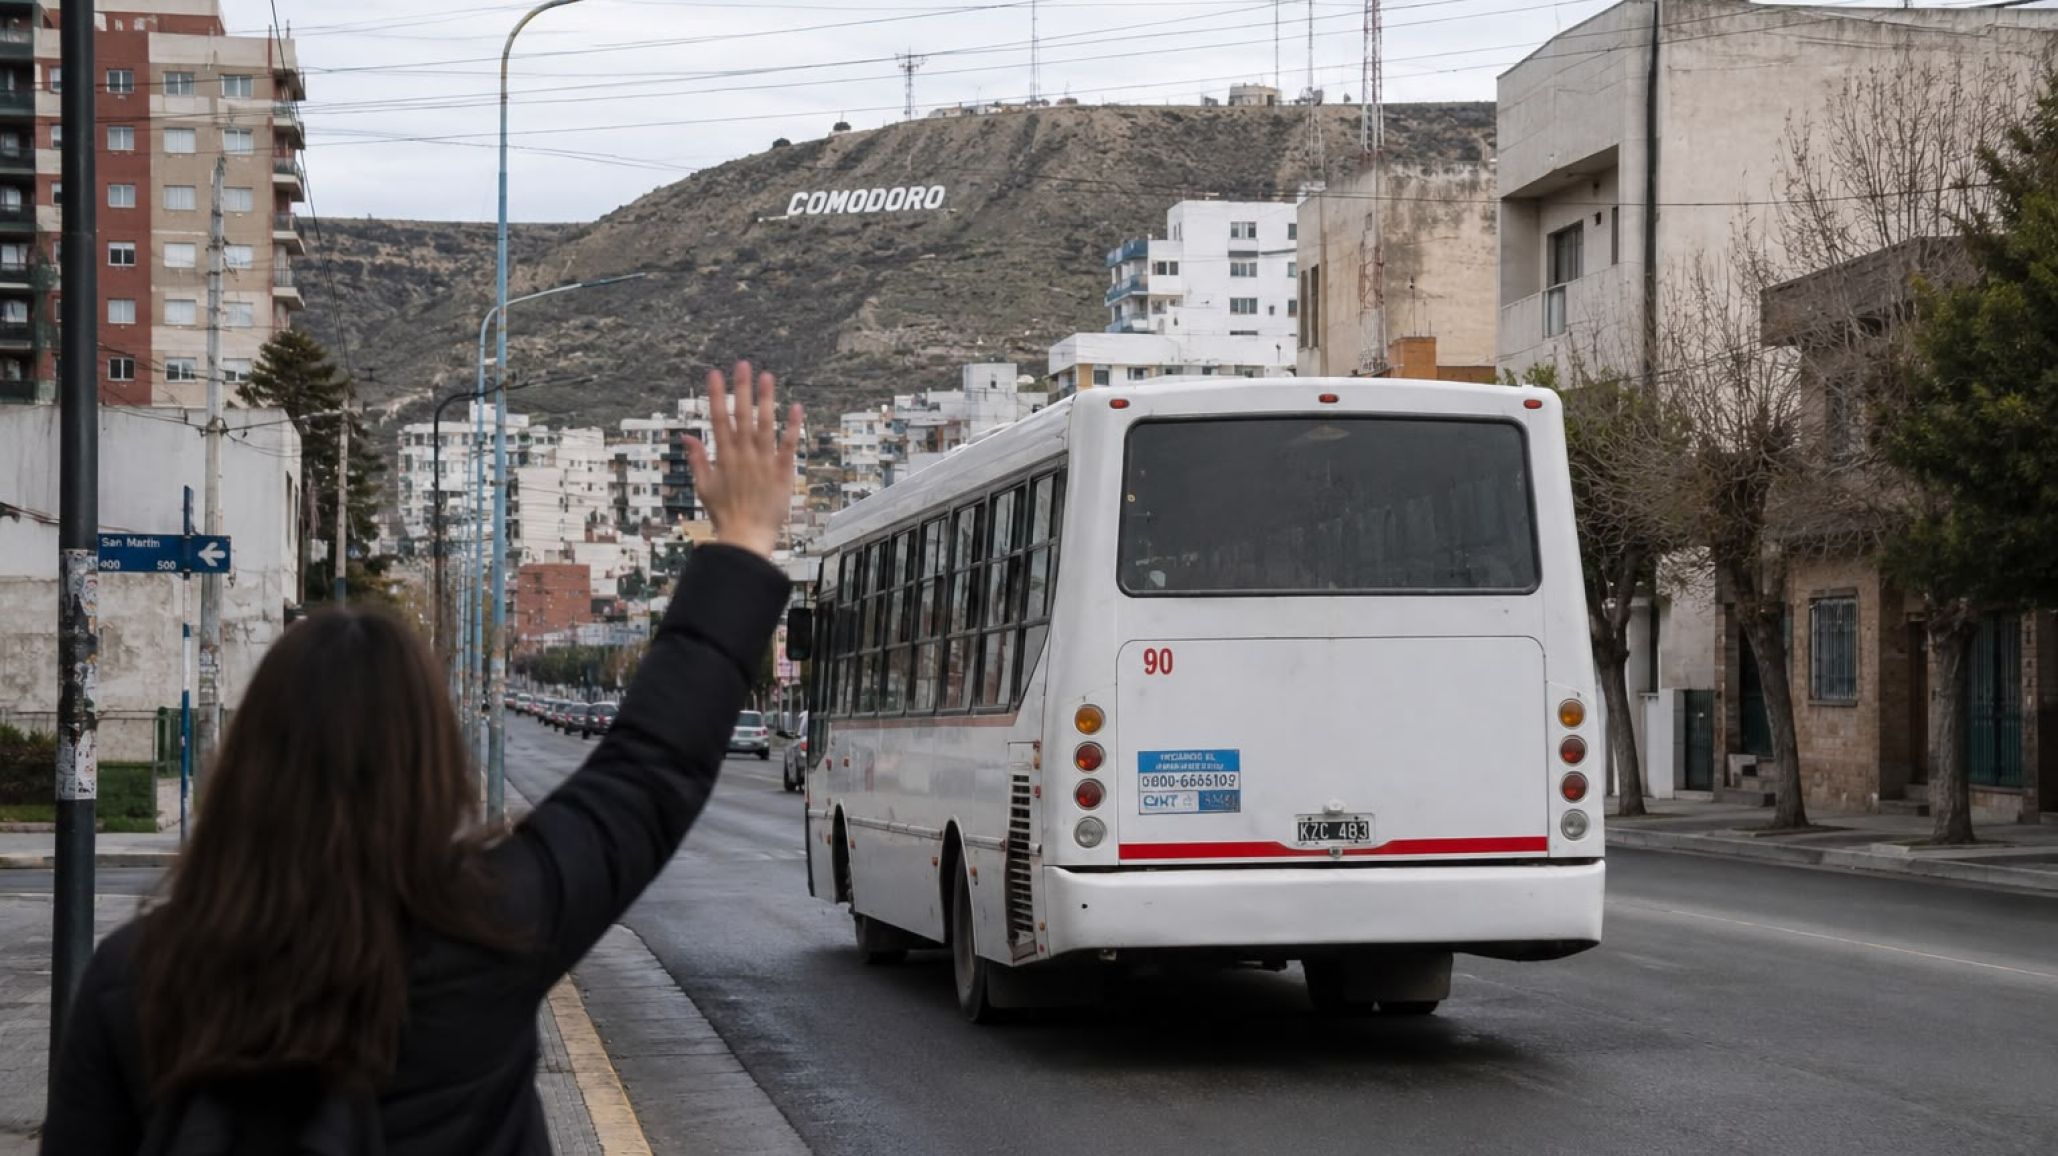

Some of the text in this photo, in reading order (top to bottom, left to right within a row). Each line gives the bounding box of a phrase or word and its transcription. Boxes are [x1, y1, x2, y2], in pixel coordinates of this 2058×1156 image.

[787, 185, 946, 216] COMODORO
[101, 537, 122, 547] San
[156, 560, 176, 570] 500
[1143, 648, 1173, 675] 90
[1300, 822, 1368, 840] KZC 483
